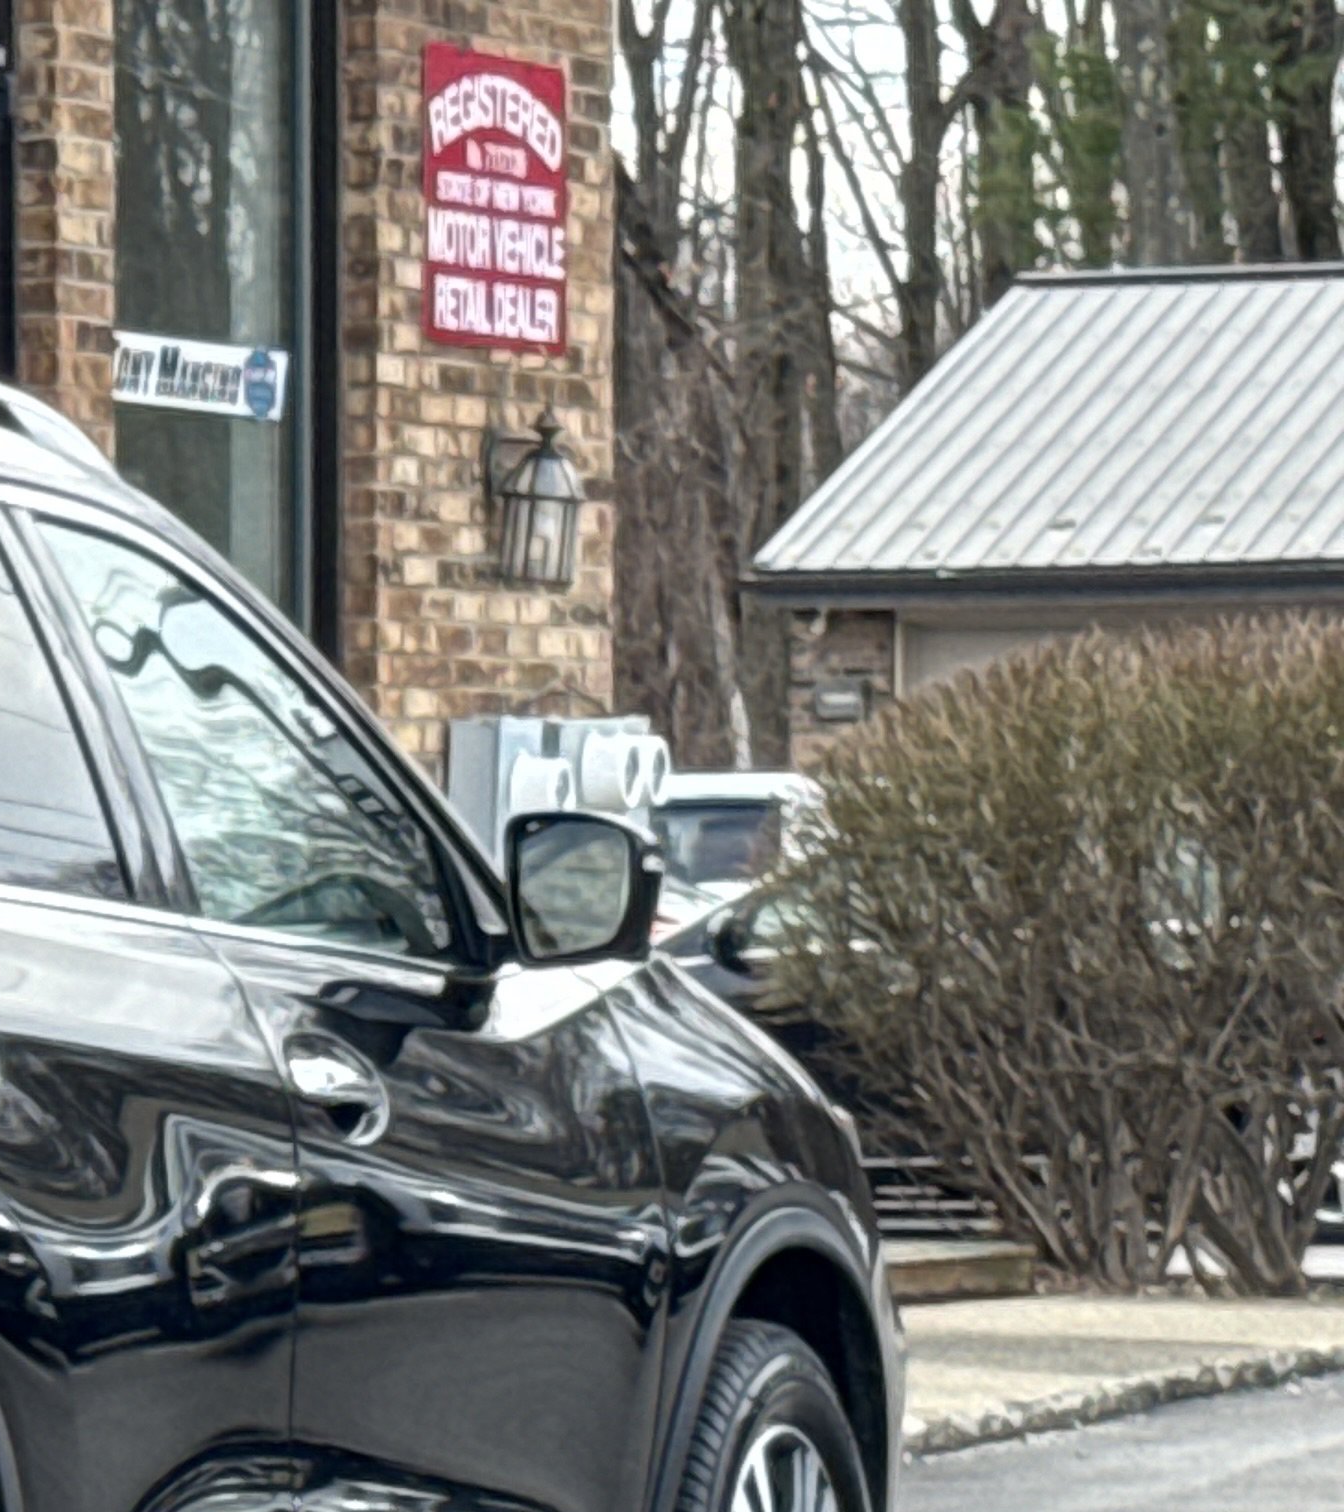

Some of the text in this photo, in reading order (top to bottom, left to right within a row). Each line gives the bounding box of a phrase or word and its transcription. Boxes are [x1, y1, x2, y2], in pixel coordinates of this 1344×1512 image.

[428, 72, 563, 173] REGISTERED
[428, 205, 565, 280] MOTOR VEHICLE
[433, 272, 560, 344] RETAIL DEALER
